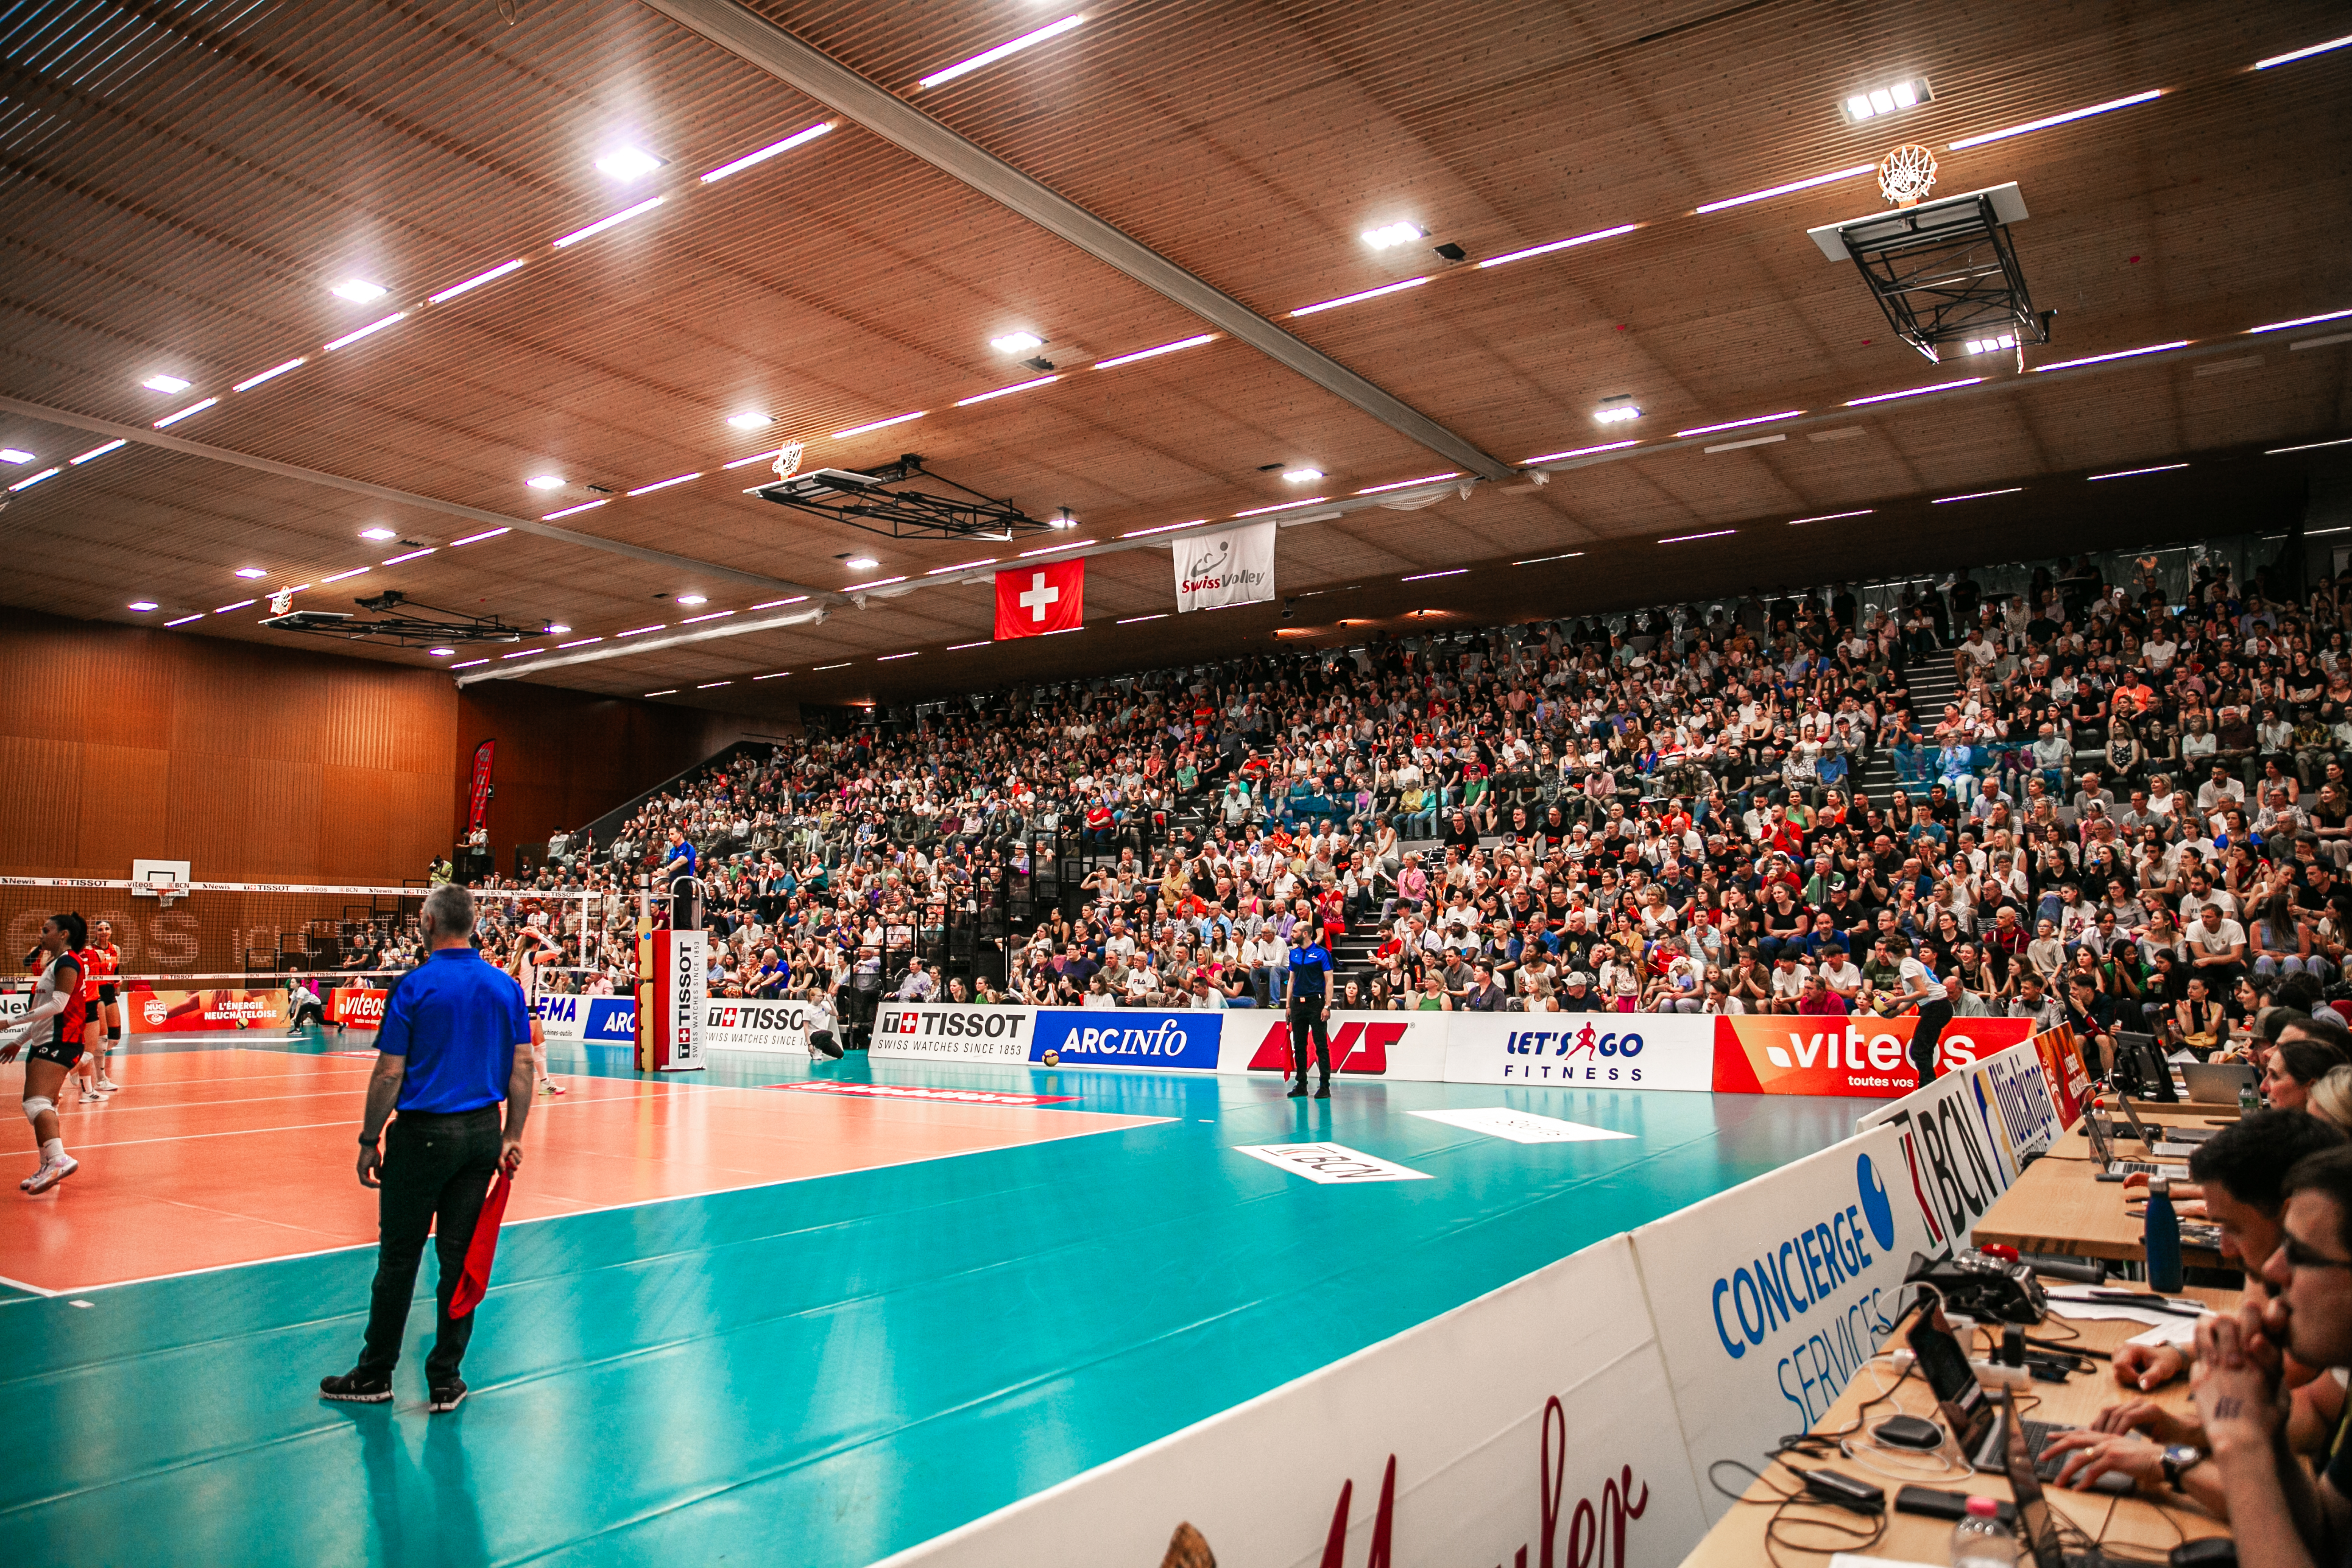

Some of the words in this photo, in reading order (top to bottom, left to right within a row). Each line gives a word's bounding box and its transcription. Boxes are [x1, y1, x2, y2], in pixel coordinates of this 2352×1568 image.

[679, 941, 691, 1026] TISSOT
[204, 1009, 277, 1020] NEUCHÂTELOISE
[219, 1000, 264, 1011] L'ÉNERGIE
[740, 1008, 803, 1031] TISSO
[922, 1012, 1026, 1038] TISSOT
[732, 1033, 768, 1044] WATCHES
[772, 1036, 797, 1046] SINCE
[878, 1039, 908, 1050] SWISS
[913, 1040, 959, 1053] WATCHES
[963, 1043, 994, 1054] SINCE
[1000, 1045, 1022, 1055] 1853
[1507, 1031, 1573, 1056] LET'S
[1598, 1033, 1644, 1058] GO
[1505, 1065, 1642, 1081] FITNESS
[1848, 1075, 1889, 1087] toutes
[1891, 1078, 1914, 1087] vos
[1988, 1054, 2055, 1148] flückiger
[1917, 1090, 1998, 1238] BCN
[1712, 1204, 1872, 1359] CONCIERGE
